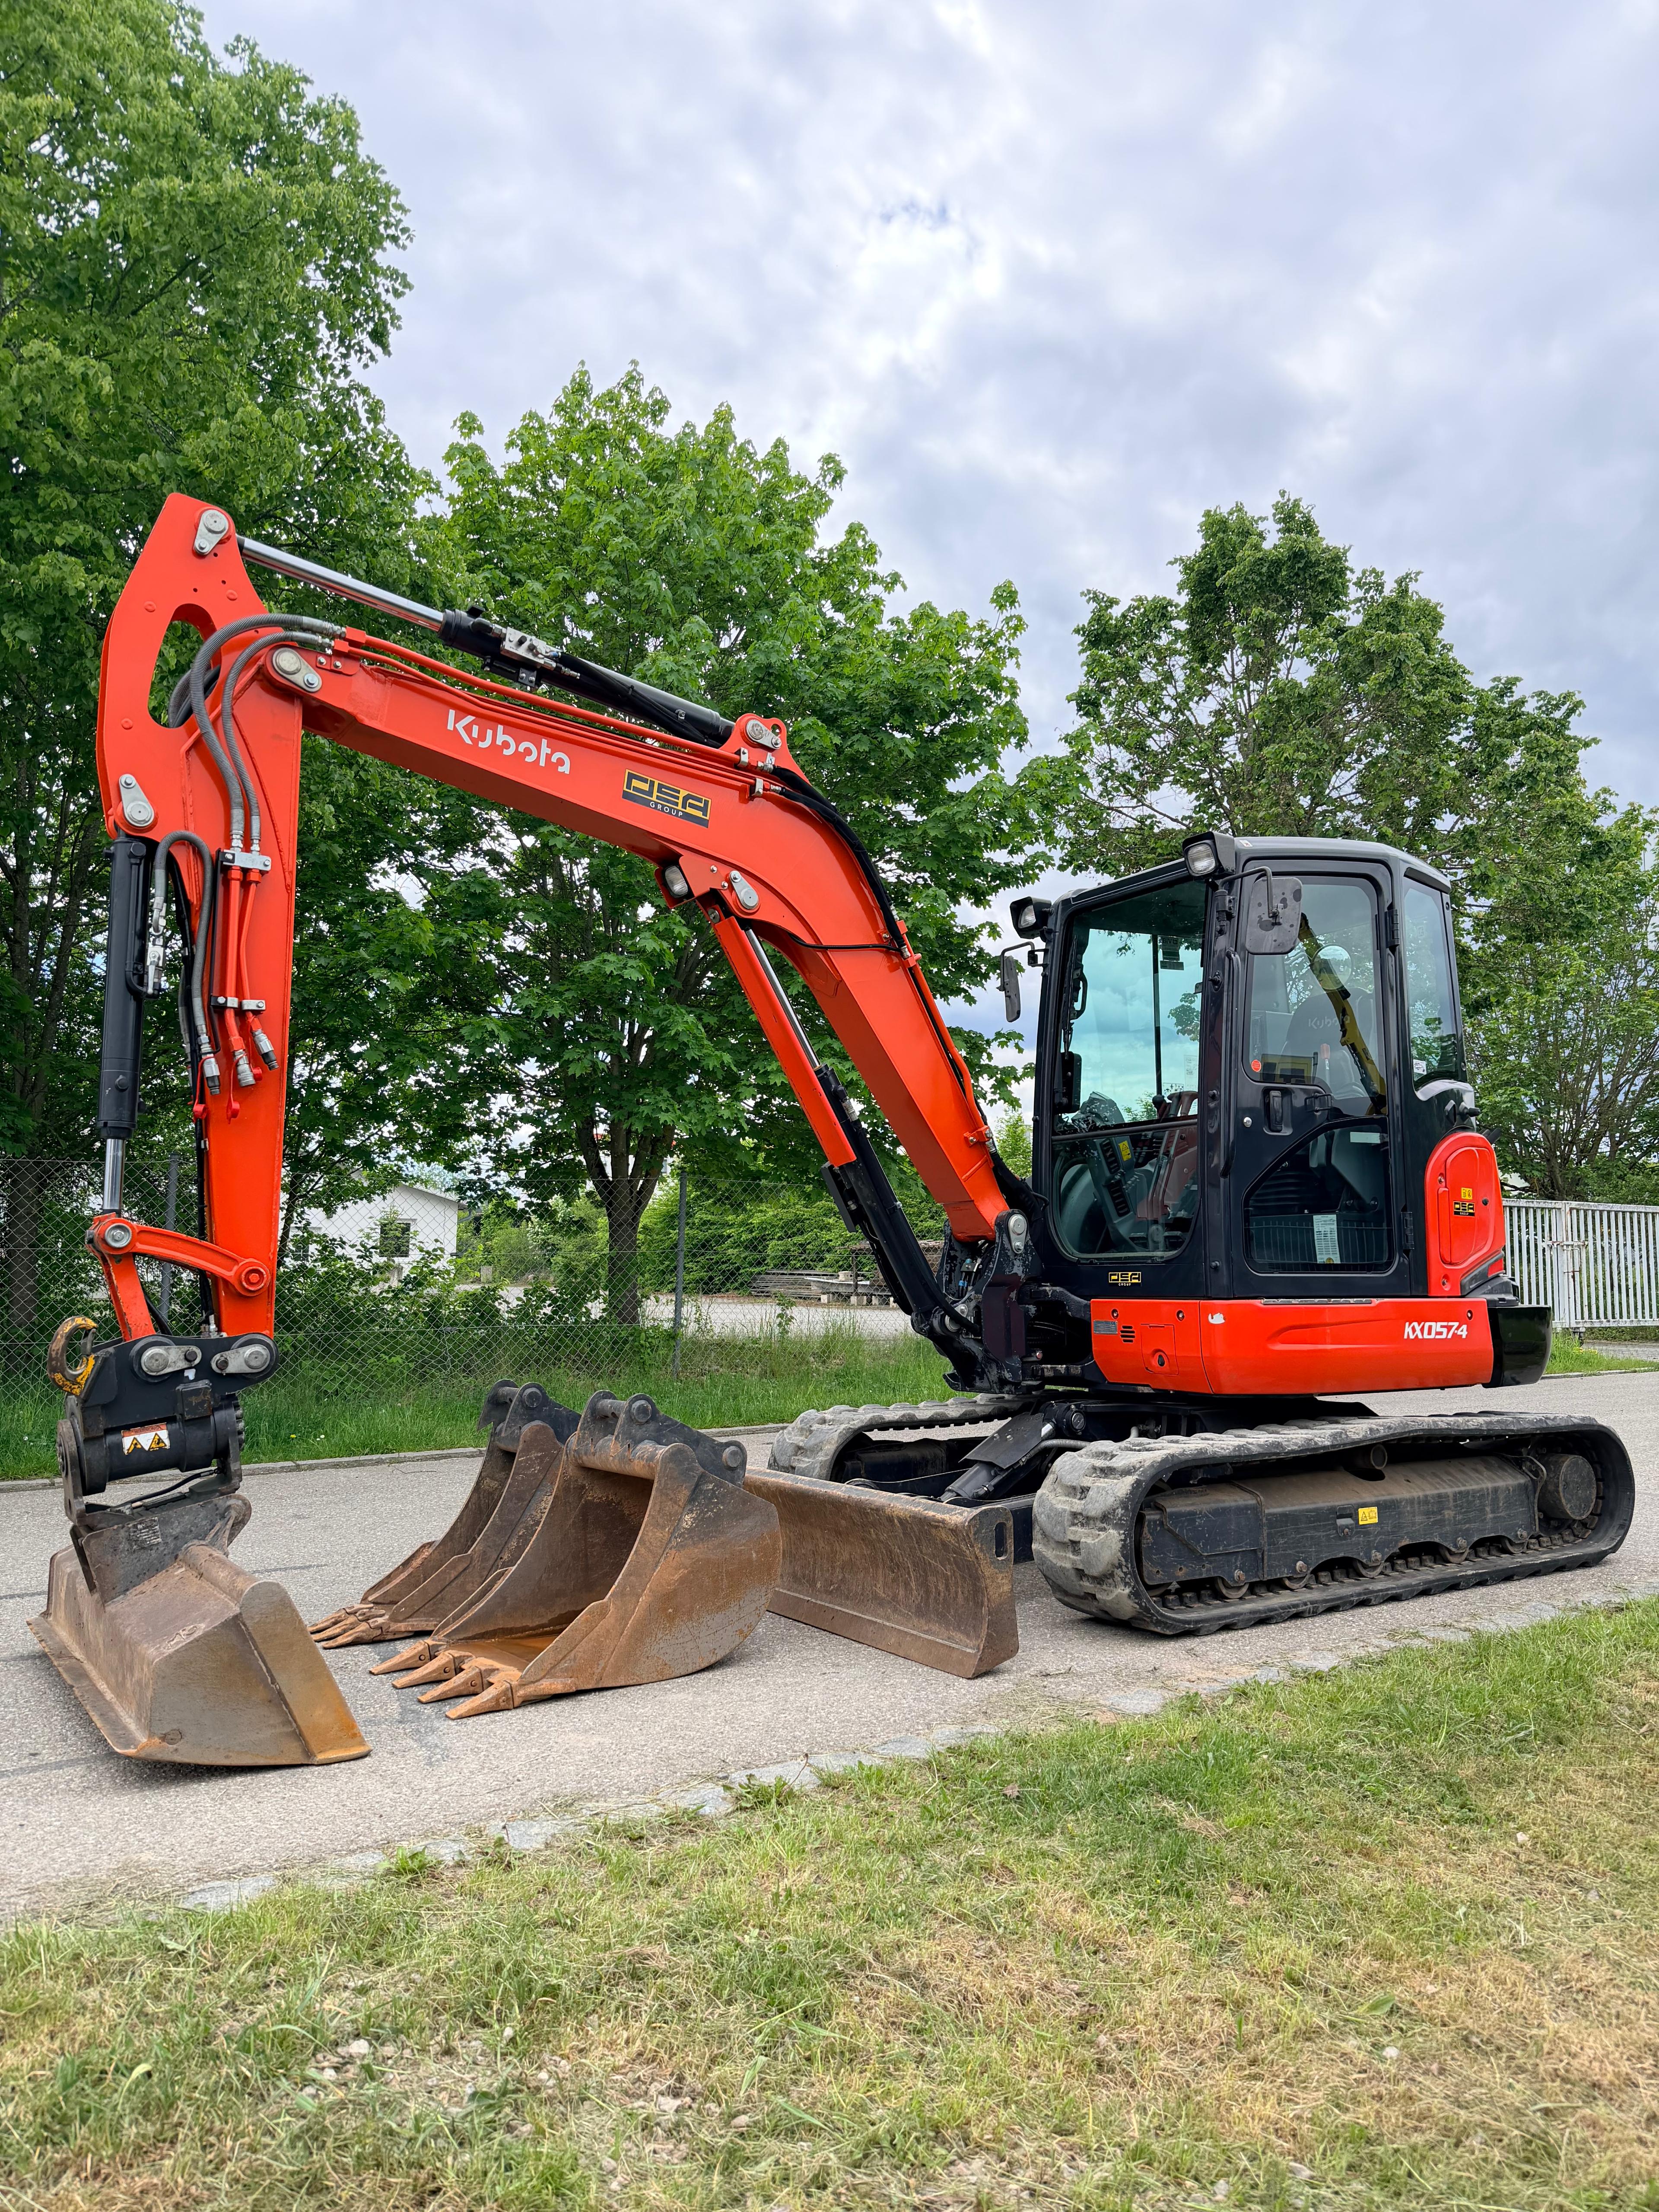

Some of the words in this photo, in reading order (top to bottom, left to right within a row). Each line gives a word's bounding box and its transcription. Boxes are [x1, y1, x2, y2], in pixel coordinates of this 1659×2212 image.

[447, 709, 571, 775] Kubota
[650, 801, 683, 817] GROUP
[1308, 1014, 1350, 1029] Kubota
